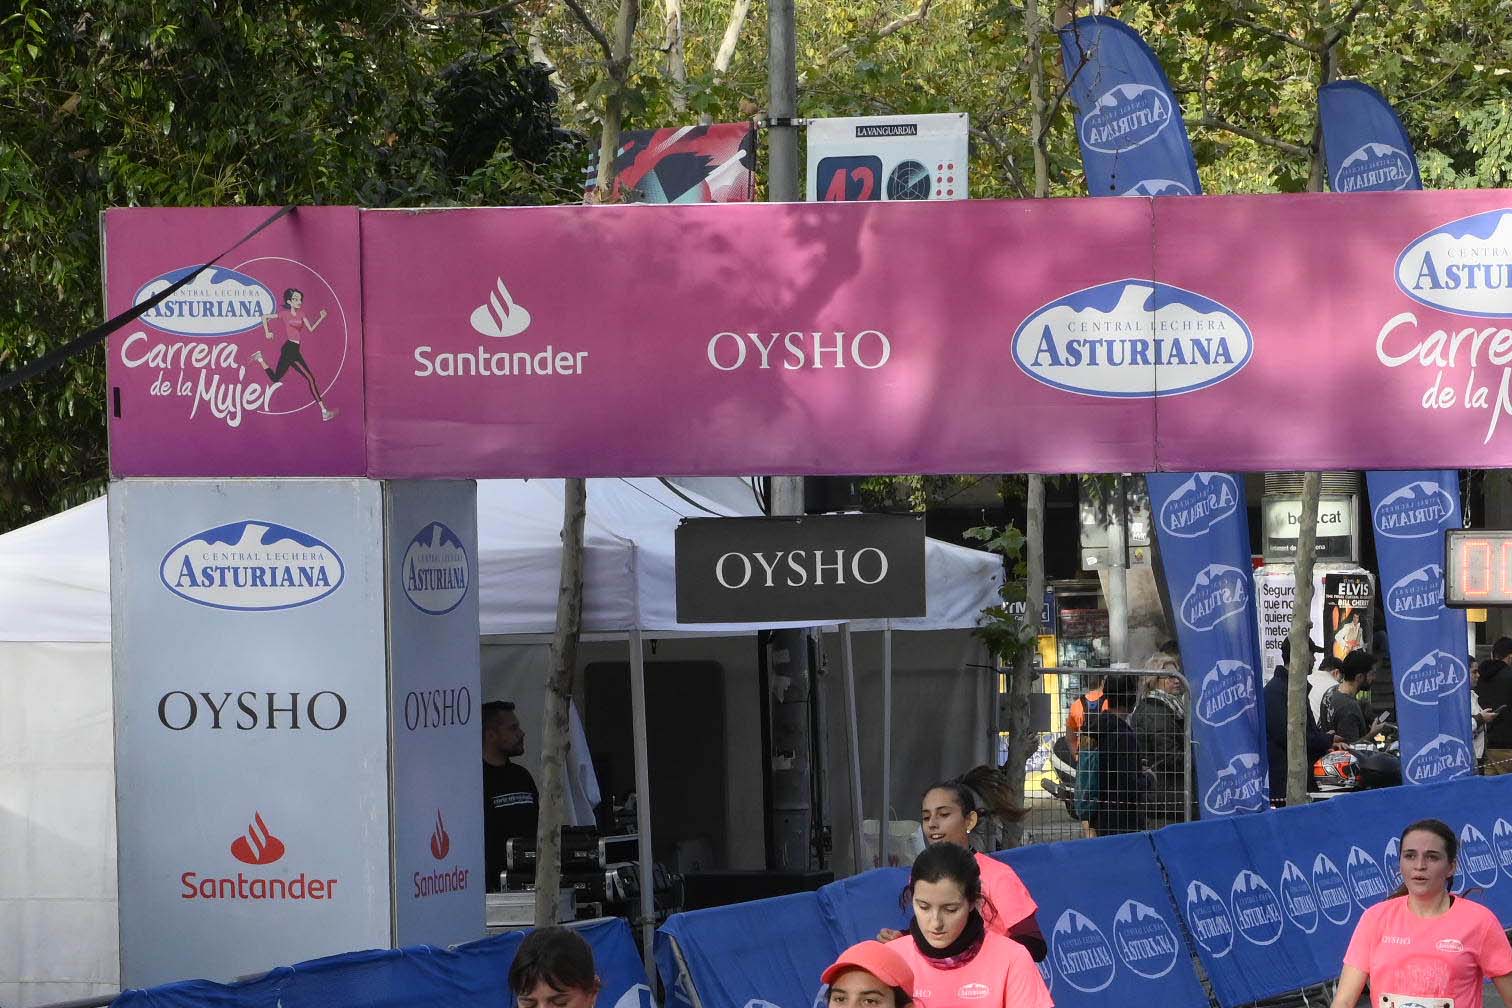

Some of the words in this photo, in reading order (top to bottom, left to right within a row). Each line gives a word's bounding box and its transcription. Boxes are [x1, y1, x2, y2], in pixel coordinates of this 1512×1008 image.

[1067, 321, 1142, 334] CENTRAL
[1150, 319, 1227, 332] LECHERA
[121, 331, 238, 368] Carrera
[414, 345, 588, 376] Santander
[707, 330, 891, 370] OYSHO
[1031, 323, 1234, 368] ASTURIANA
[150, 370, 172, 396] de
[177, 370, 193, 396] la
[189, 365, 283, 427] Mujer
[1422, 371, 1456, 409] de
[1464, 371, 1489, 409] la
[175, 555, 331, 588] ASTURIANA
[203, 552, 259, 561] CENTRAL
[266, 551, 324, 561] LECHERA
[715, 547, 889, 589] OYSHO
[408, 556, 465, 591] ASTURIANA
[1339, 583, 1369, 595] ELVIS
[1264, 602, 1280, 613] que
[158, 691, 347, 731] OYSHO
[405, 687, 471, 731] OYSHO
[182, 873, 337, 900] Santander
[414, 867, 468, 898] Santander
[1058, 944, 1112, 975] ASTURIANA
